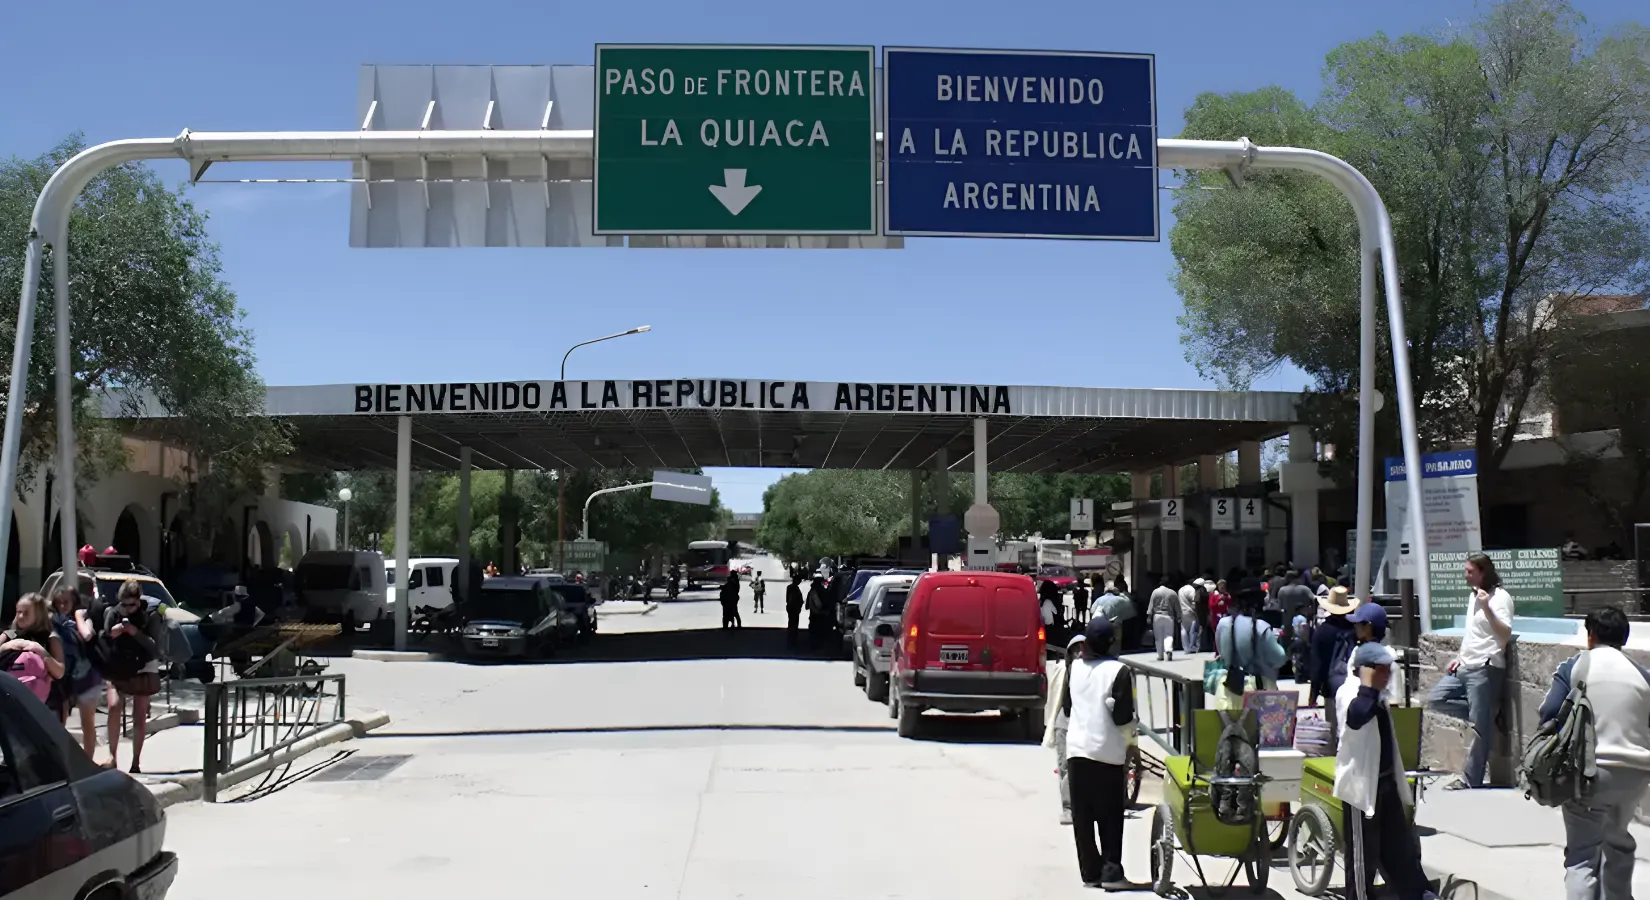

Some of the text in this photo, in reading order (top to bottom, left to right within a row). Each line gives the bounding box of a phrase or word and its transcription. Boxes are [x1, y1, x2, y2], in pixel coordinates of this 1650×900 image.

[605, 68, 865, 97] PASO DE FRONTERA
[937, 74, 1104, 105] BIENVENIDO
[641, 118, 830, 147] LA QUIACA
[899, 127, 1143, 160] A LA REPUBLICA
[943, 181, 1101, 212] ARGENTINA
[354, 379, 1011, 414] BIENVENIDO A LA REPUBLICA ARGENTINA
[1076, 499, 1087, 516] 1
[1167, 499, 1177, 516] 2
[1217, 499, 1227, 516] 3
[1245, 498, 1255, 516] 4
